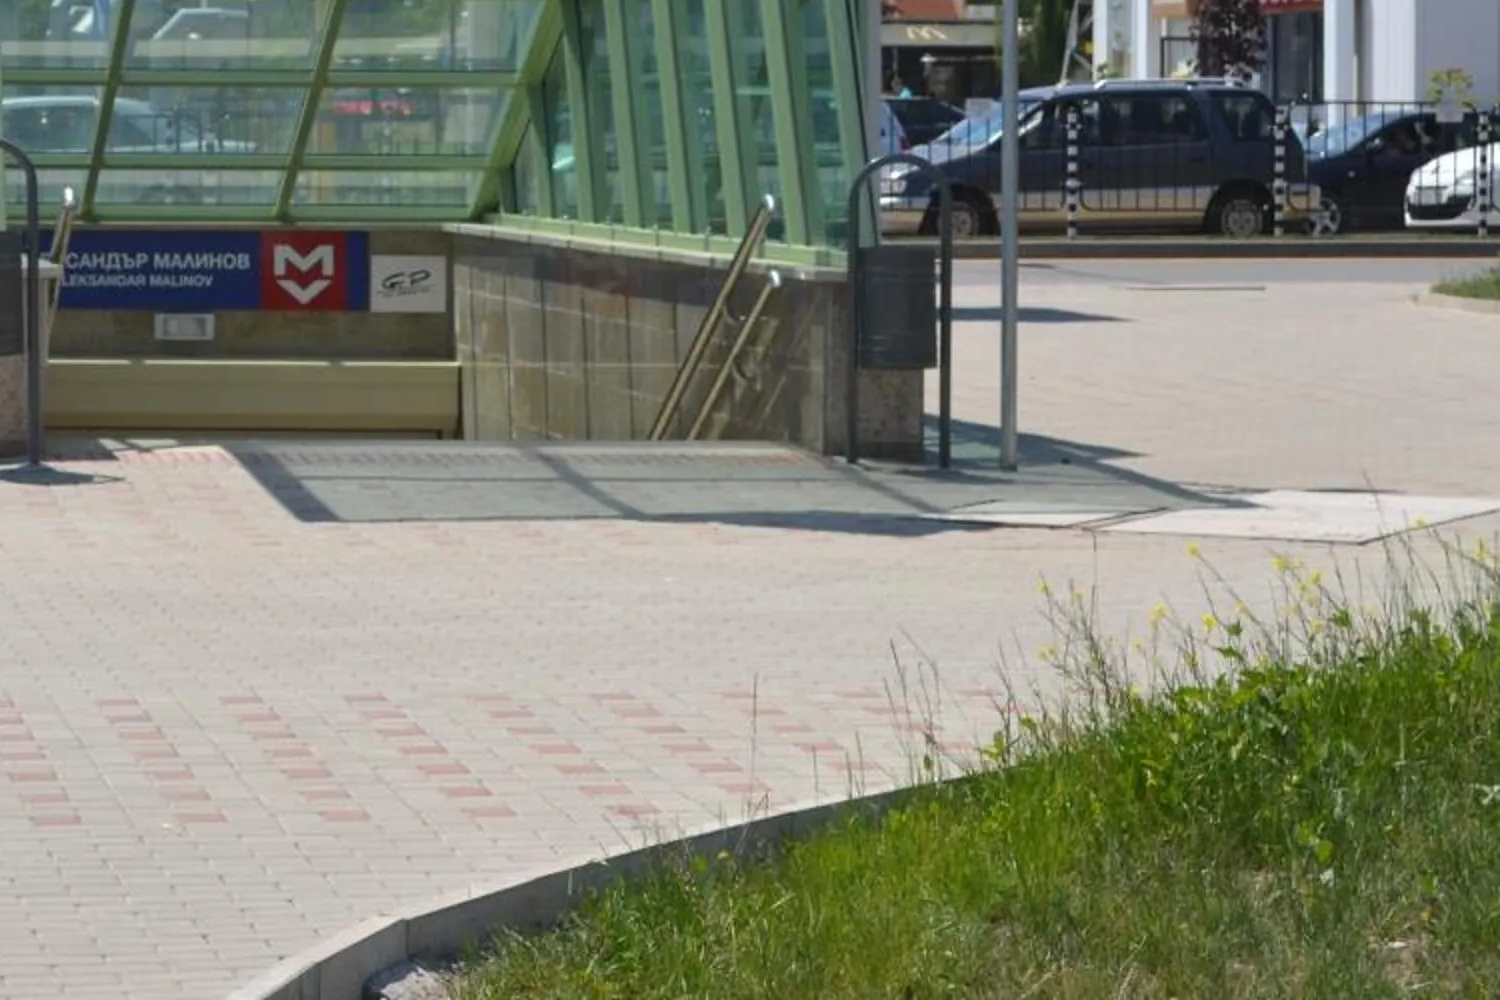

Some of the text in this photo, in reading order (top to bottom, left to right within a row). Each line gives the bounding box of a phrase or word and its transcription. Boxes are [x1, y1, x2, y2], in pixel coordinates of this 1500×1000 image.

[66, 251, 251, 271] САНДЪР МАЛИНОВ
[62, 274, 214, 287] LEKSANDAR MALINOV
